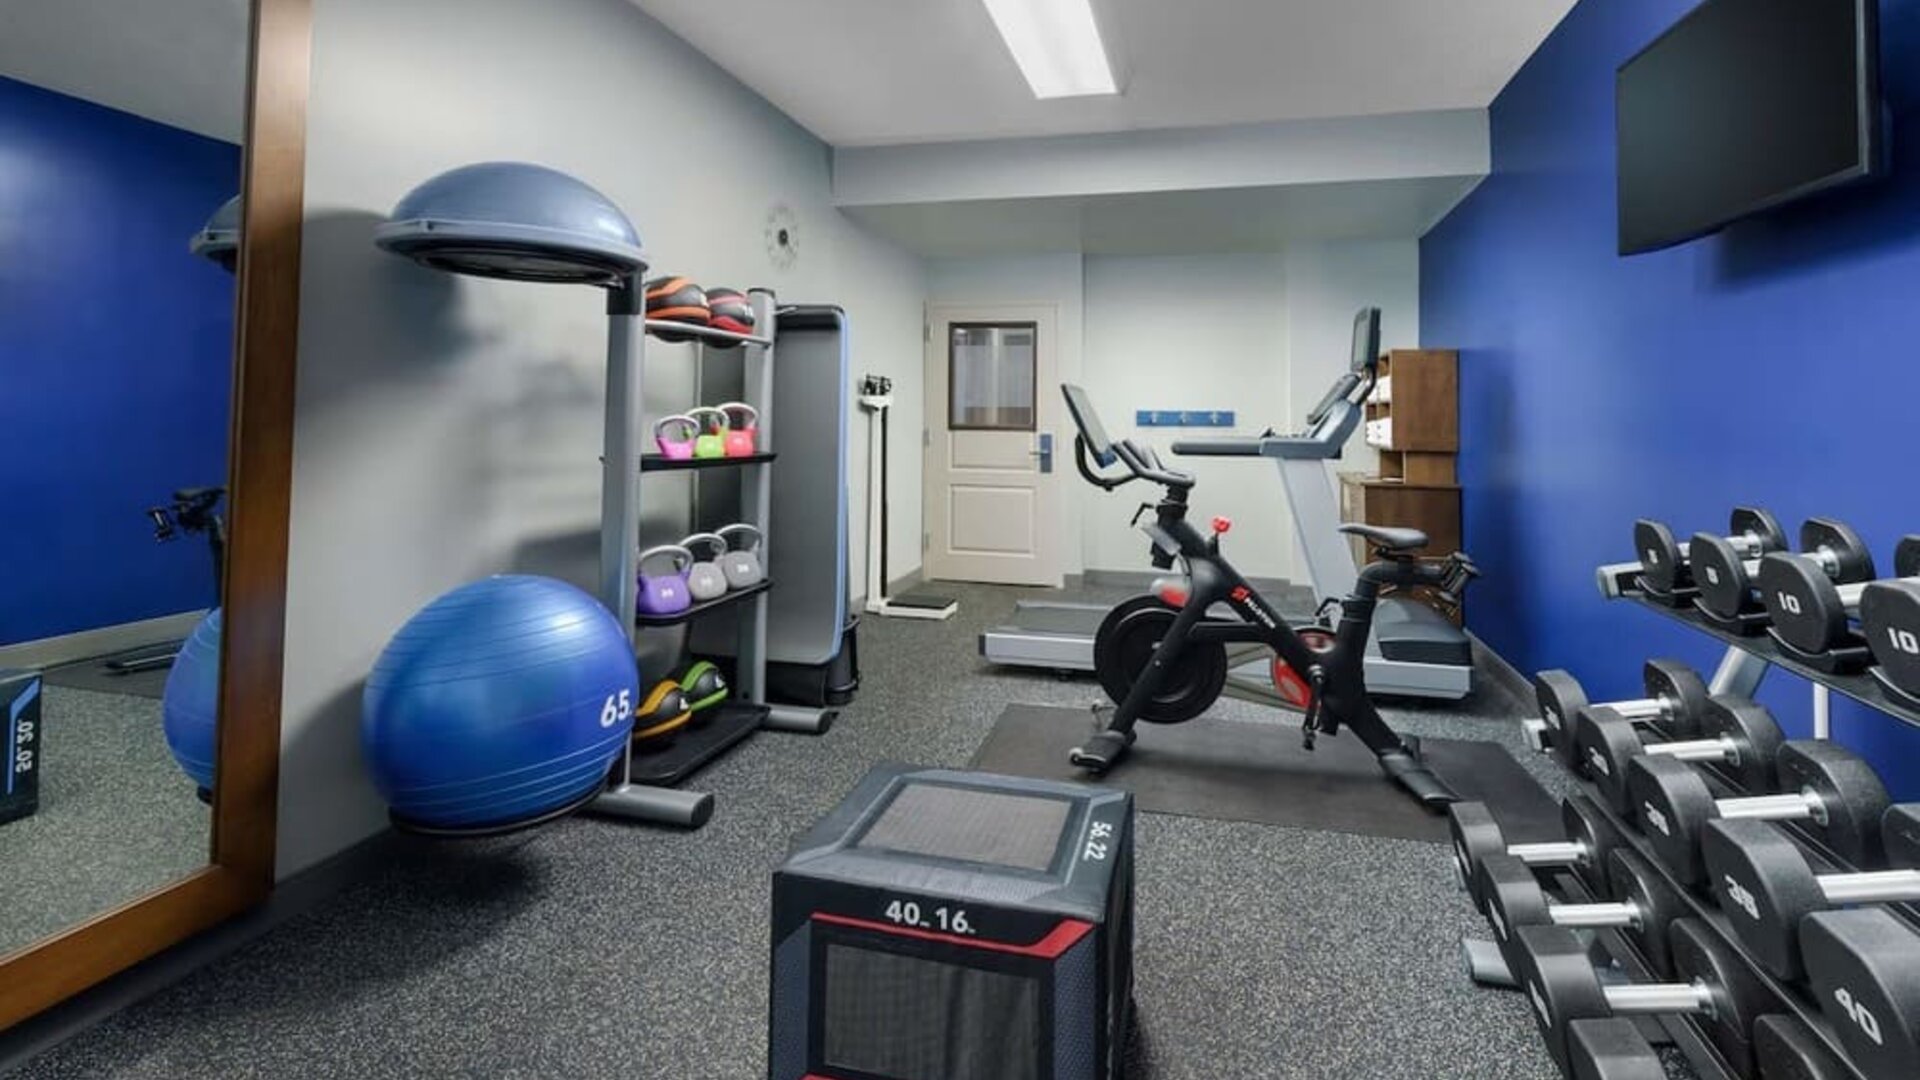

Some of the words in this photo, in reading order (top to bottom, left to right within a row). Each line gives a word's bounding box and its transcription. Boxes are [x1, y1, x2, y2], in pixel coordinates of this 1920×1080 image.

[1777, 591, 1801, 614] 10
[1887, 627, 1919, 654] 10
[600, 688, 630, 728] 65
[1083, 840, 1107, 861] 22
[885, 900, 920, 925] 40
[935, 907, 969, 933] 16
